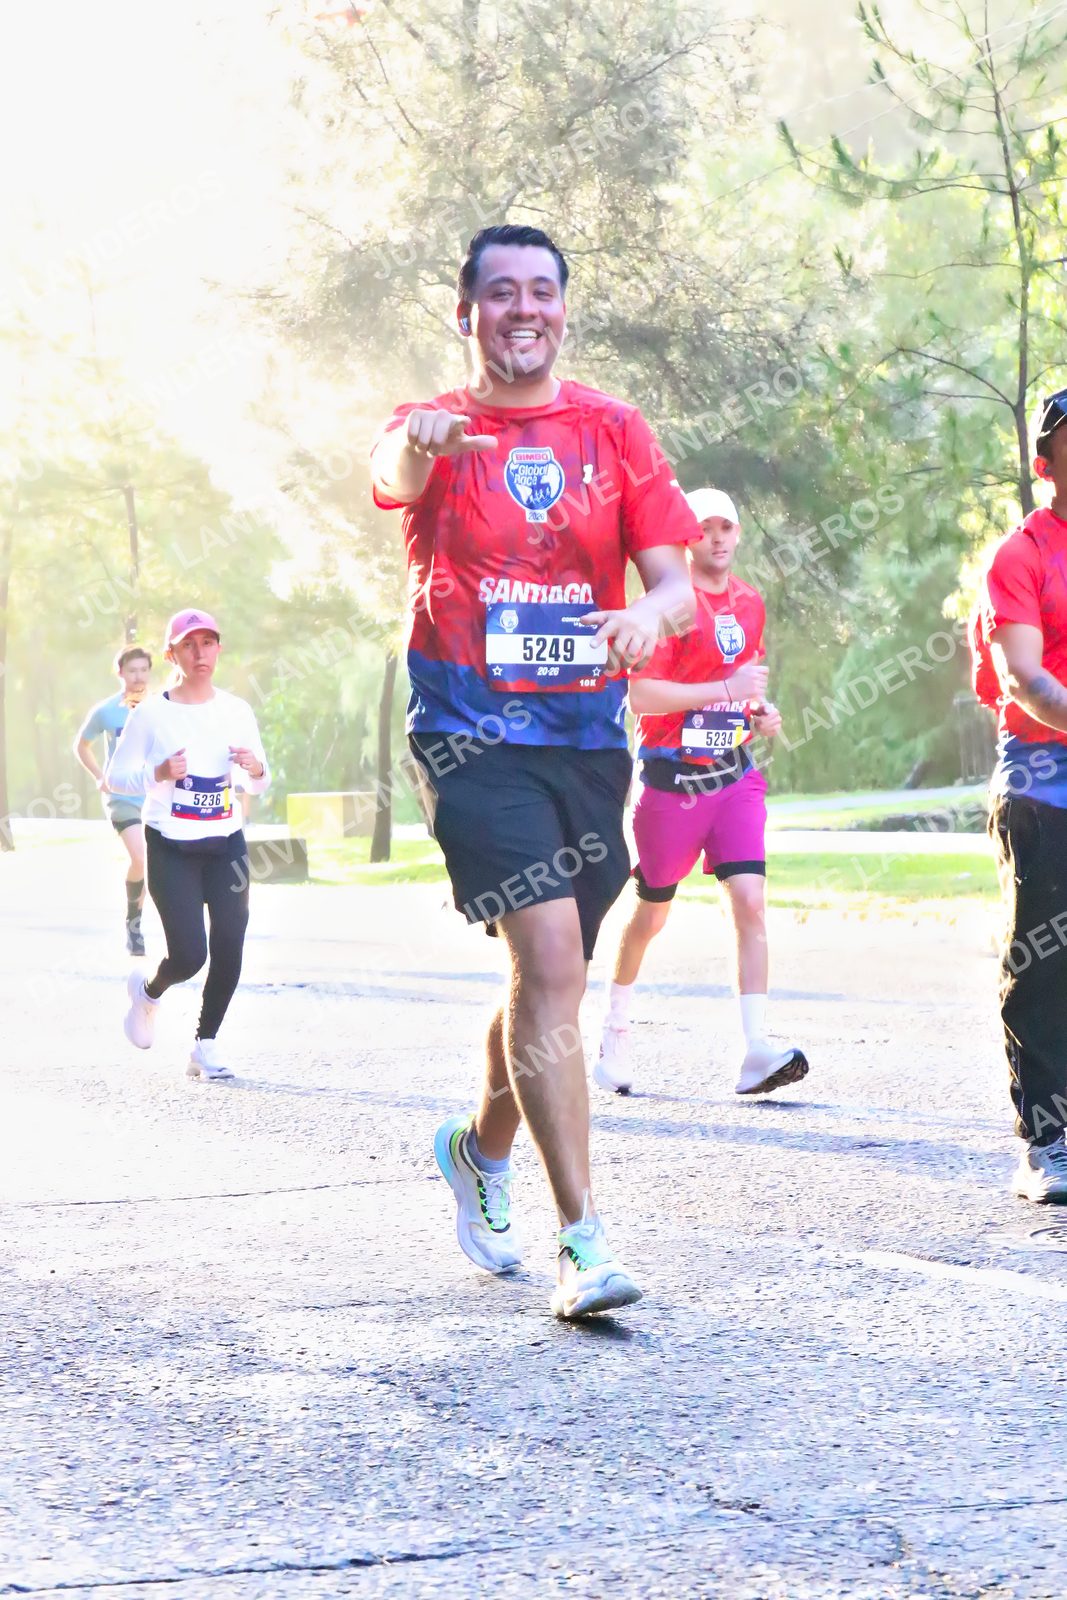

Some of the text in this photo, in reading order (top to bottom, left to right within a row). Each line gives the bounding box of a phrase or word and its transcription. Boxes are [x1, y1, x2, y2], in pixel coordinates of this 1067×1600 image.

[515, 453, 549, 461] BIMBO
[518, 464, 548, 476] Global
[514, 474, 537, 486] Race
[478, 577, 594, 604] SANTIAGO
[522, 637, 575, 662] 5249
[706, 731, 734, 747] 5234
[193, 793, 222, 807] 5236
